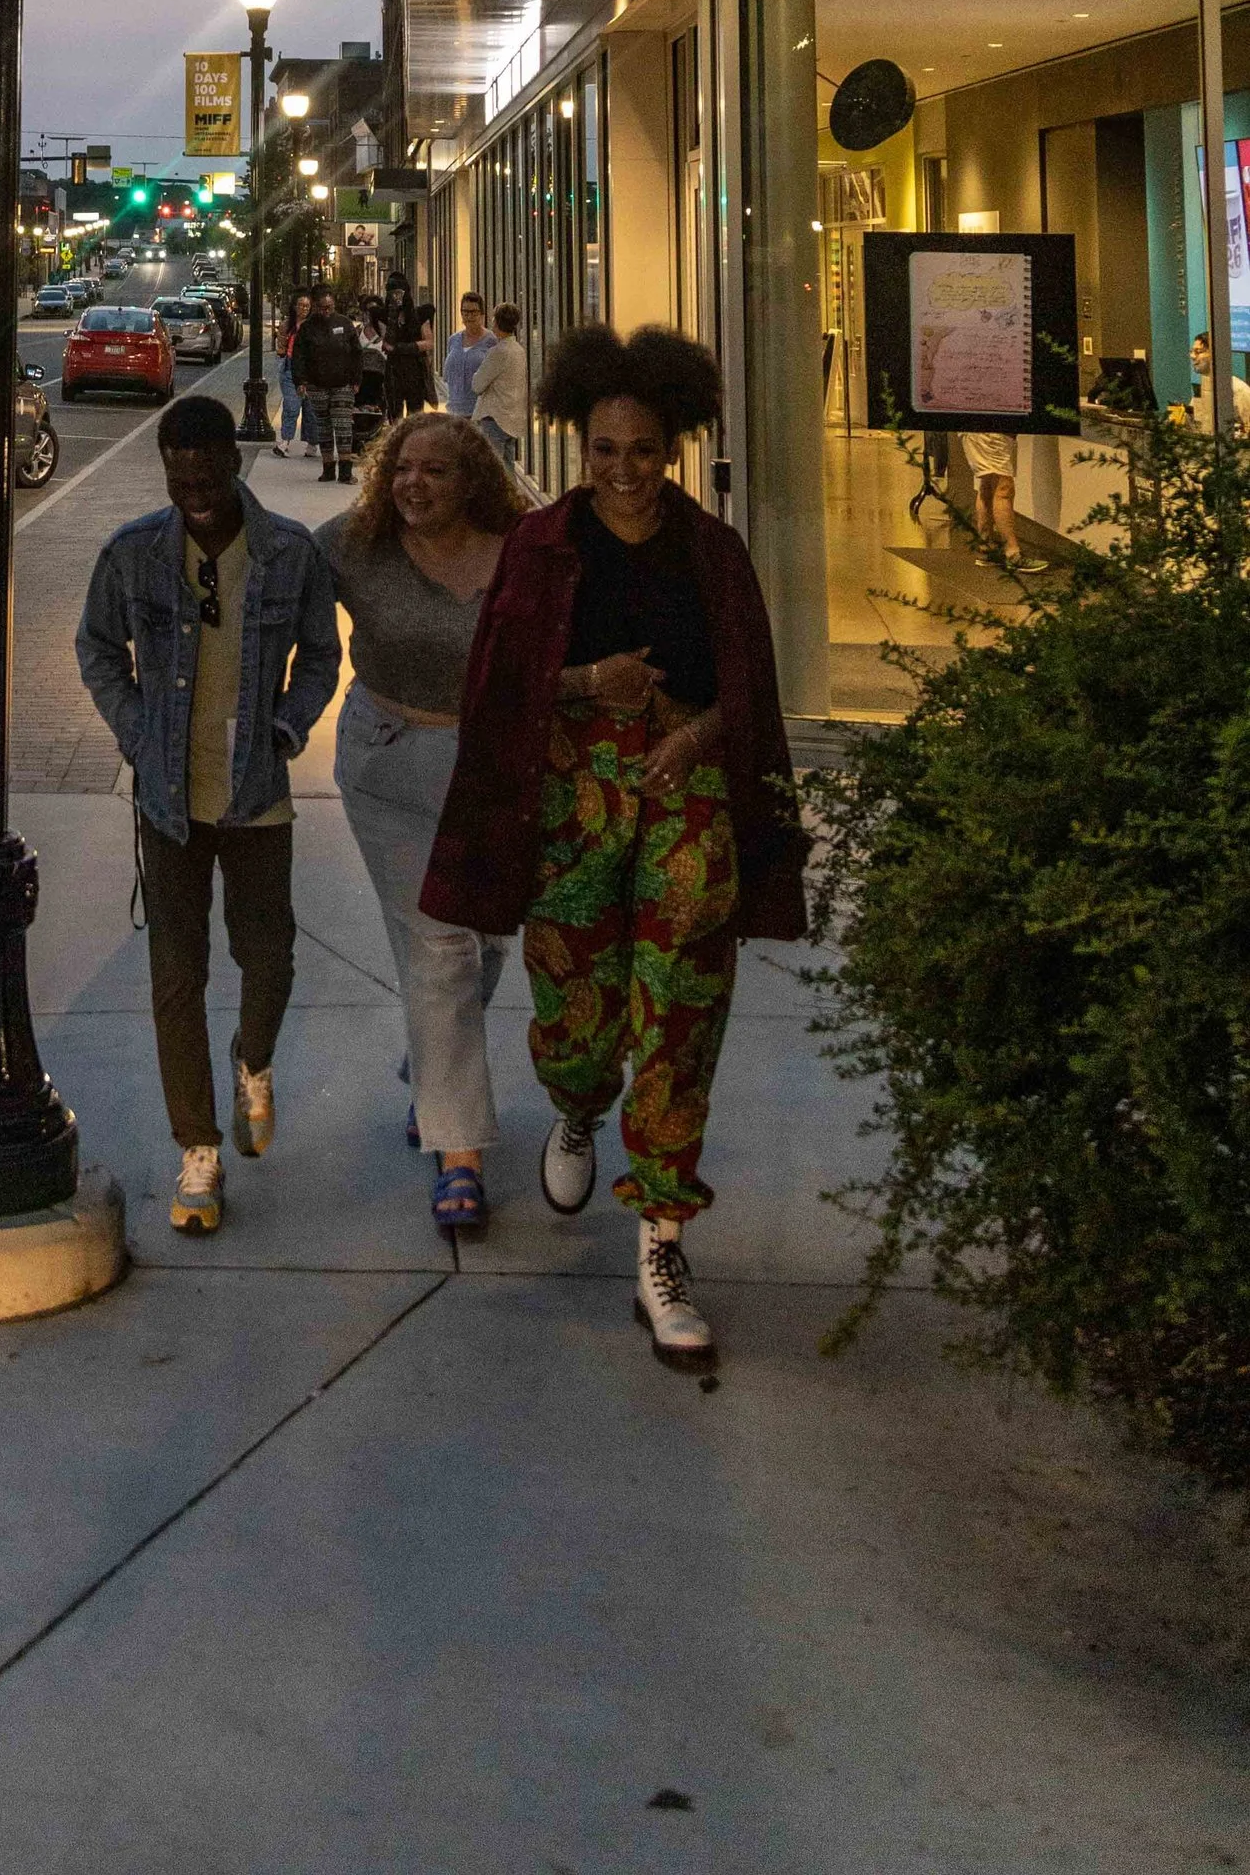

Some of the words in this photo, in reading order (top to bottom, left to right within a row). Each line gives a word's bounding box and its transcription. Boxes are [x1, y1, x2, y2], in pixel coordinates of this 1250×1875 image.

[195, 61, 208, 72] 10
[194, 73, 228, 83] DAYS
[195, 85, 217, 95] 100
[194, 96, 232, 106] FILMS
[195, 113, 232, 126] MIFF
